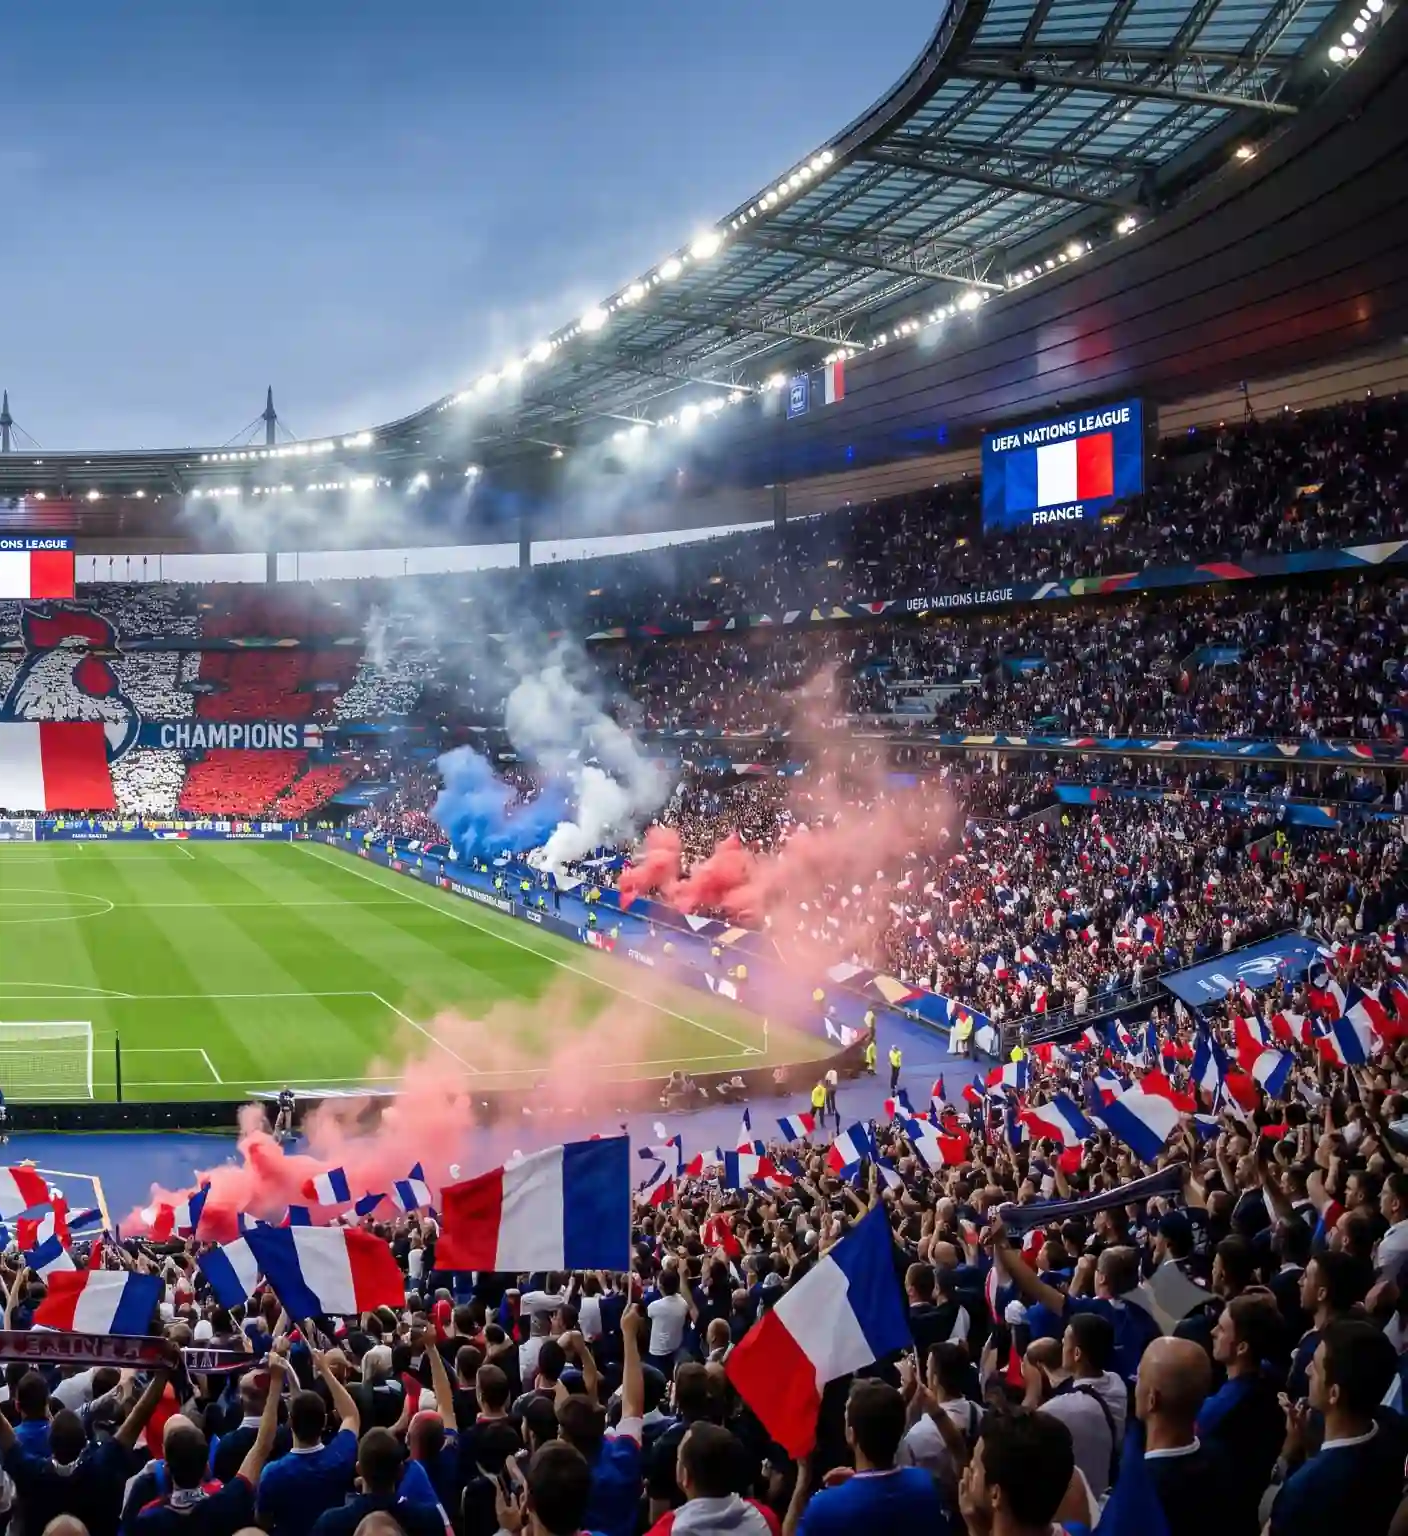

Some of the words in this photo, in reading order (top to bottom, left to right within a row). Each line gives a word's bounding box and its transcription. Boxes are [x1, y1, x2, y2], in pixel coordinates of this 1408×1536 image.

[992, 435, 1021, 452] UEFA
[1023, 421, 1077, 445] NATIONS
[1079, 408, 1130, 433] LEAGUE
[1032, 505, 1084, 525] FRANCE
[25, 539, 68, 549] LEAGUE
[906, 597, 929, 611] UEFA
[931, 593, 973, 608] NATIONS
[974, 588, 1013, 603] LEAGUE
[160, 723, 298, 749] CHAMPIONS
